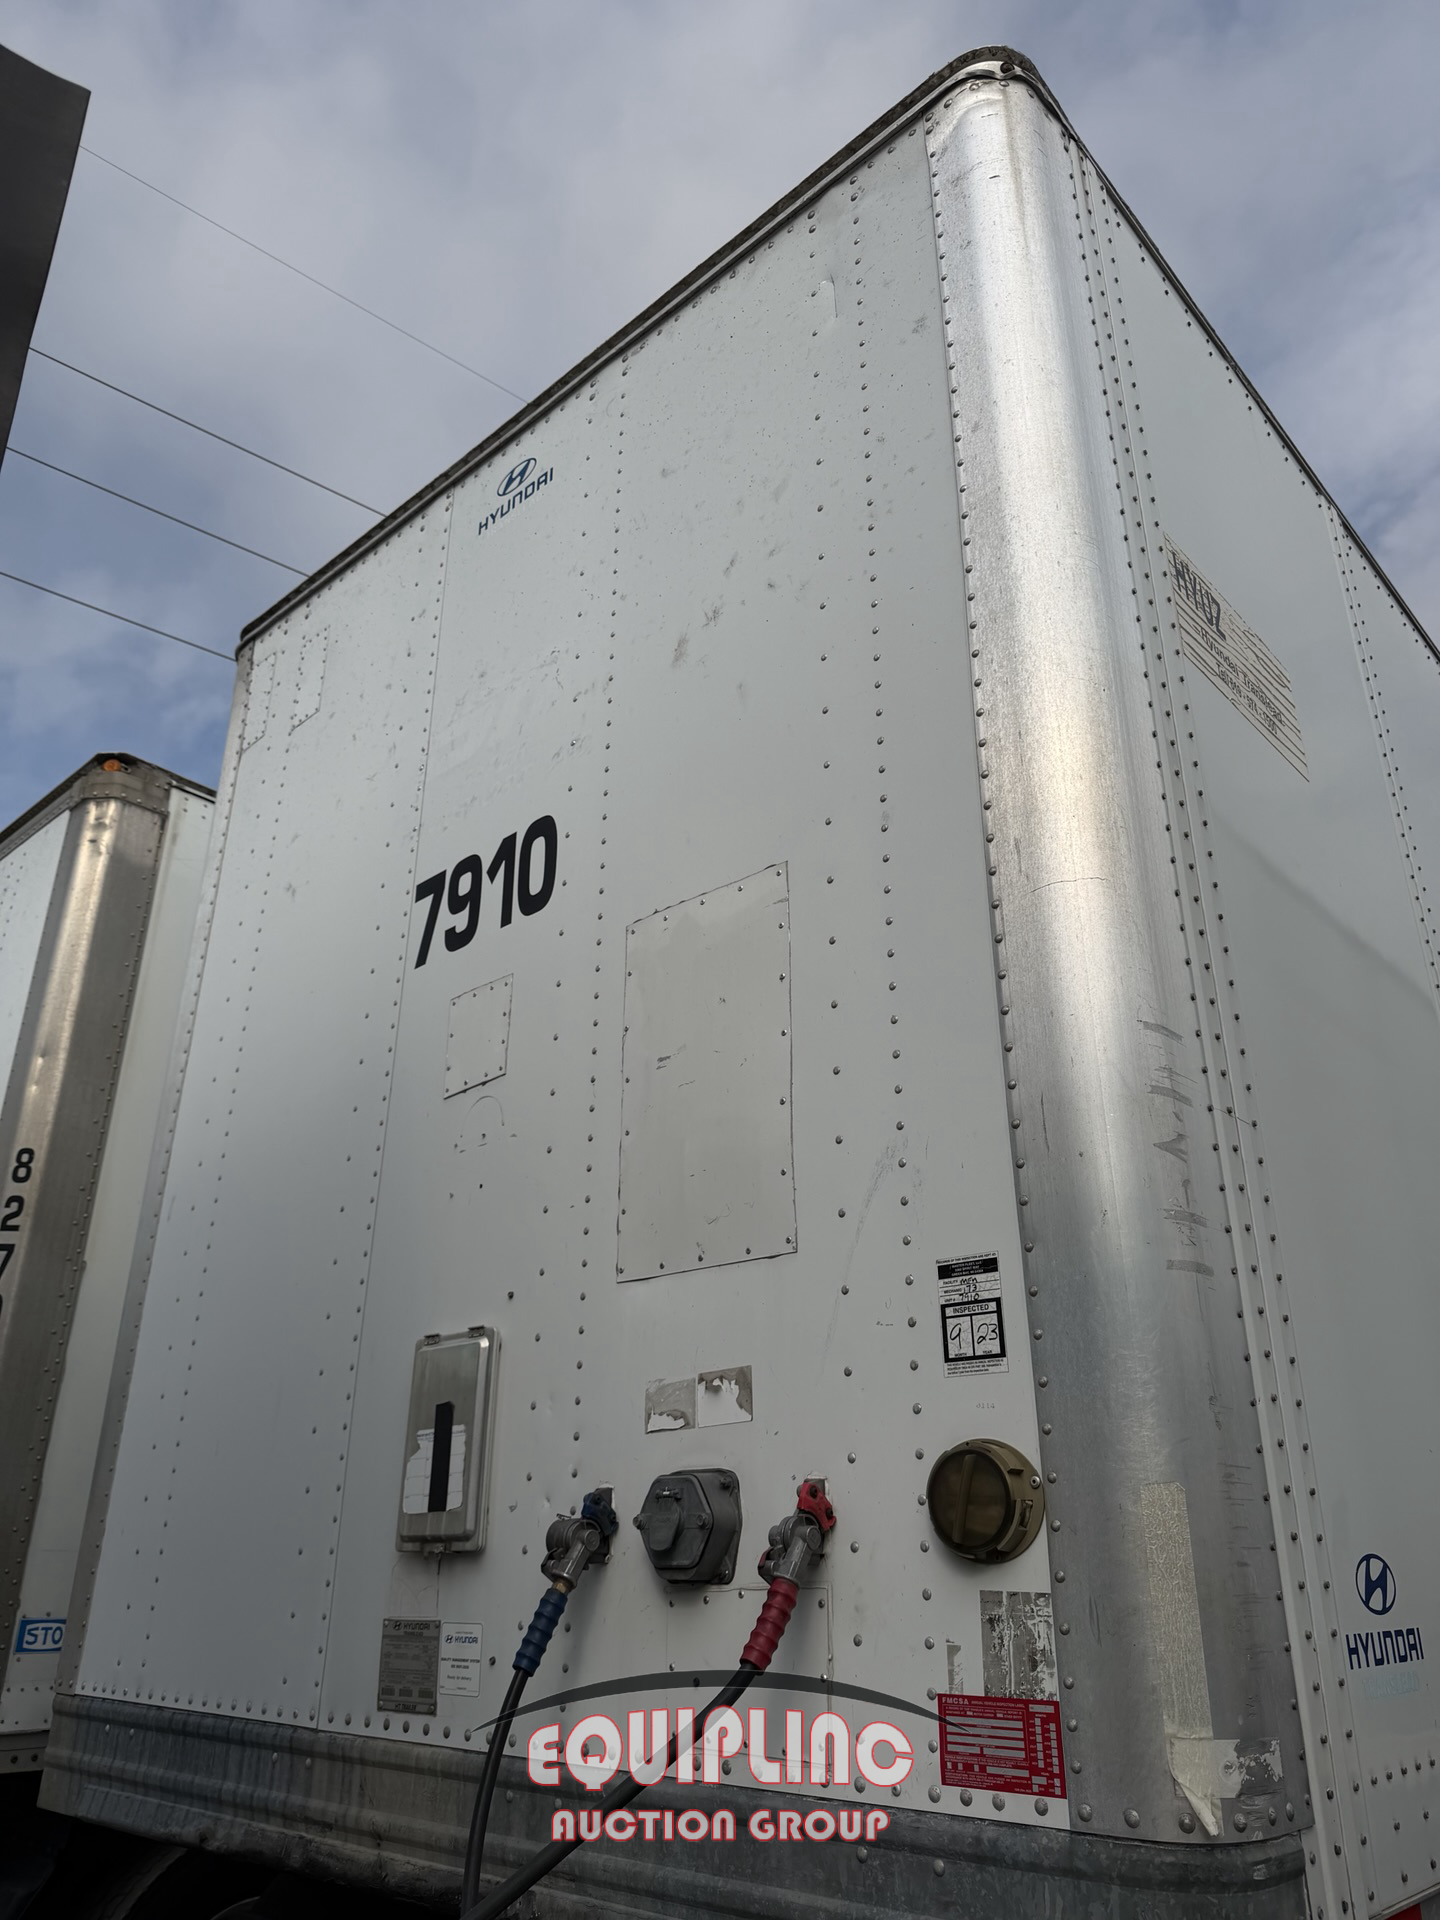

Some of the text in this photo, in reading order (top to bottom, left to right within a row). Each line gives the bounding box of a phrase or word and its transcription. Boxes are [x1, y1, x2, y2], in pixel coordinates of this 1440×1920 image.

[478, 467, 554, 536] HYUNDAI
[1200, 627, 1239, 676] Hyundai
[414, 815, 557, 970] 7910
[952, 1304, 989, 1314] INSPECTED
[950, 1323, 961, 1349] 9
[977, 1323, 998, 1344] 23
[25, 1626, 63, 1645] STO
[455, 1636, 478, 1644] HYUNDAI
[1346, 1627, 1424, 1670] HYUNDAI
[942, 1697, 969, 1705] FMCSA
